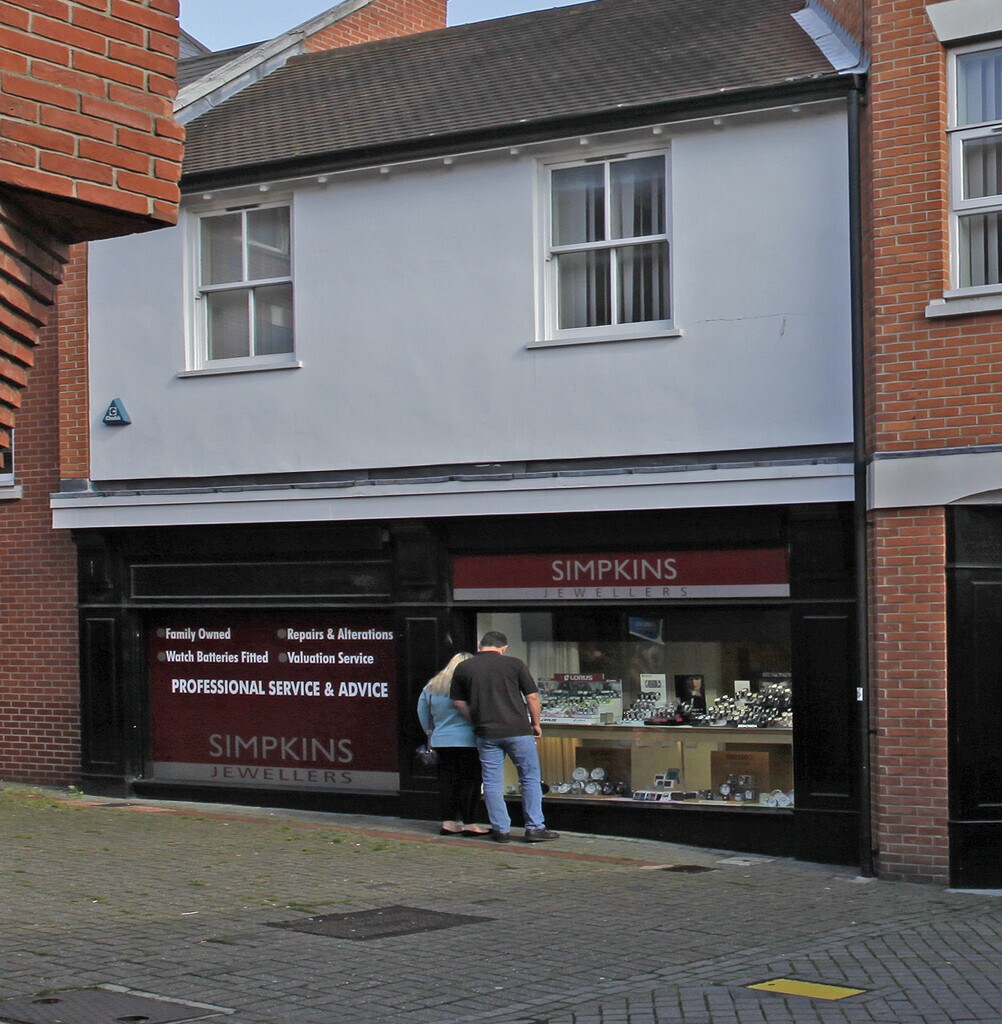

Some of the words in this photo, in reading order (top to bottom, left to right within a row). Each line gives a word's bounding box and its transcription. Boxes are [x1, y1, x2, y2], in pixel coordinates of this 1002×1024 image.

[551, 558, 678, 581] SIMPKINS
[543, 586, 688, 598] JEWELLERS
[165, 627, 196, 642] Family
[198, 628, 231, 640] Owned
[287, 628, 325, 642] Repairs
[327, 629, 335, 640] &
[337, 628, 394, 641] Alterations
[165, 650, 194, 663] Watch
[196, 651, 239, 663] Batteries
[241, 651, 269, 664] Fitted
[287, 651, 336, 664] Valuation
[337, 652, 374, 665] Service
[171, 678, 266, 696] PROFESSIONAL
[268, 680, 320, 697] SERVICE
[324, 682, 335, 697] &
[338, 681, 389, 698] ADVICE
[209, 733, 354, 763] SIMPKINS
[211, 766, 353, 784] JEWELLERS
